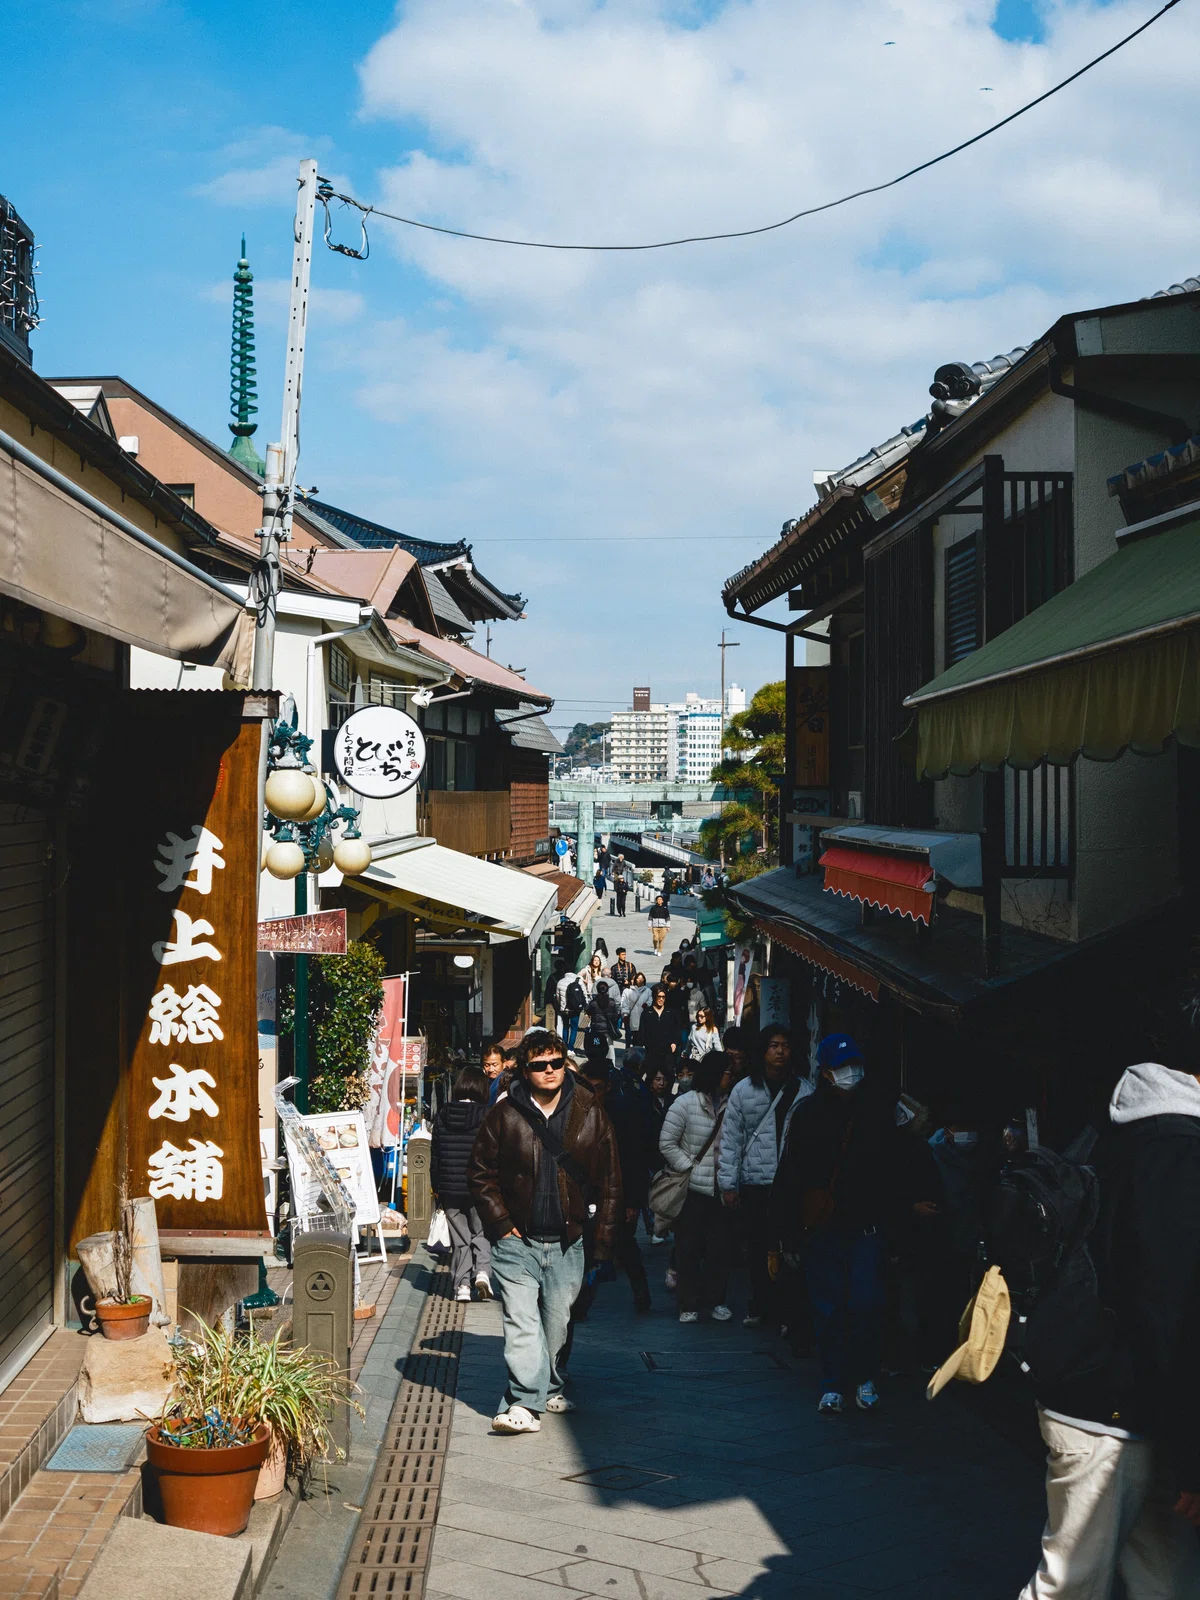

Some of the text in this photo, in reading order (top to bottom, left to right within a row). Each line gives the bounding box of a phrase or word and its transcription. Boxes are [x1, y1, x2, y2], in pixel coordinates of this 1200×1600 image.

[343, 724, 354, 777] しらす問屋
[355, 736, 414, 782] とびっちょ
[405, 729, 416, 758] 江の島
